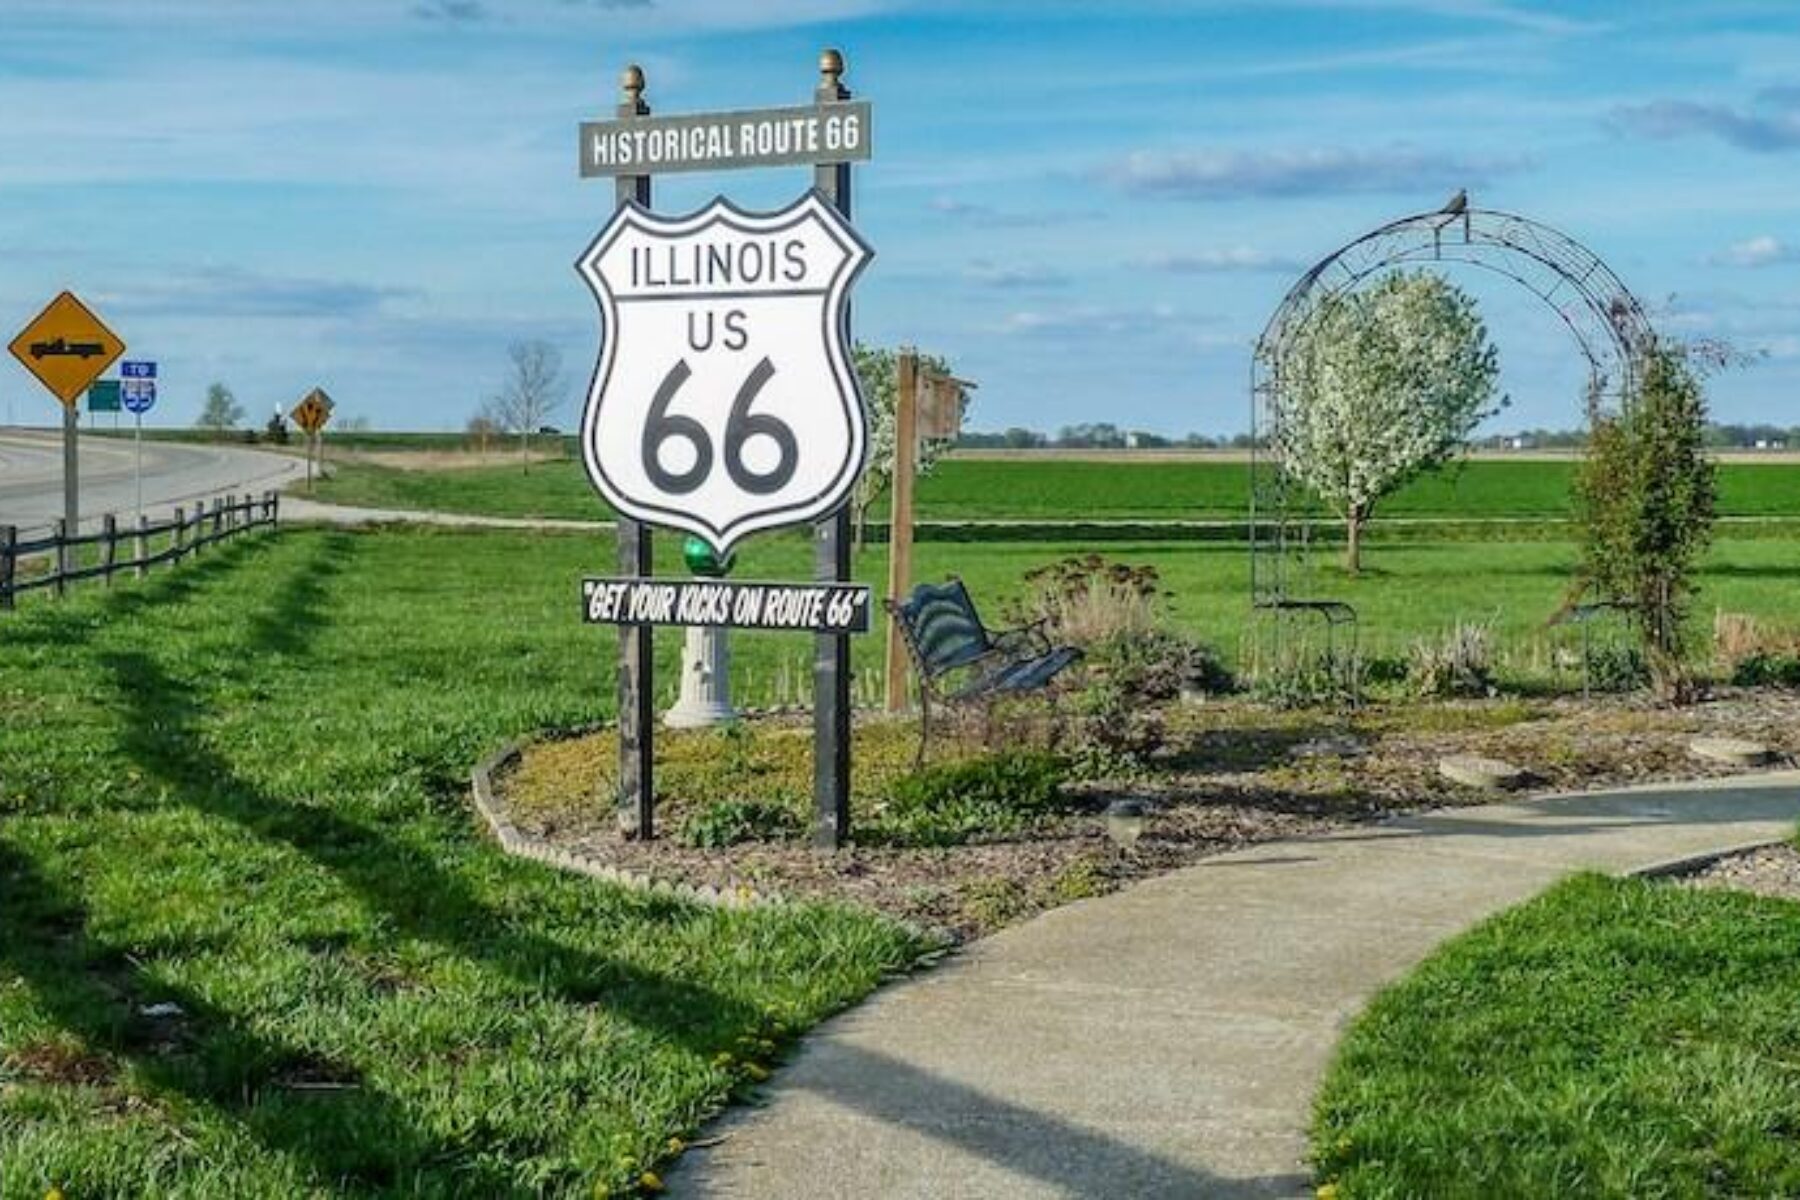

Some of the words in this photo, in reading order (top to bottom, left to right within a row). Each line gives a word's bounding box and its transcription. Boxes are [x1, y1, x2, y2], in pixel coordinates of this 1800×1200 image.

[593, 124, 733, 166] HISTORICAL
[740, 116, 818, 156] ROUTE
[825, 114, 860, 150] 66
[631, 239, 808, 288] ILLINOIS
[687, 309, 749, 353] US
[641, 355, 799, 496] 66
[628, 583, 676, 622] YOUR
[675, 584, 733, 624] KICKS
[733, 586, 765, 626] ON
[762, 588, 828, 627] ROUTE
